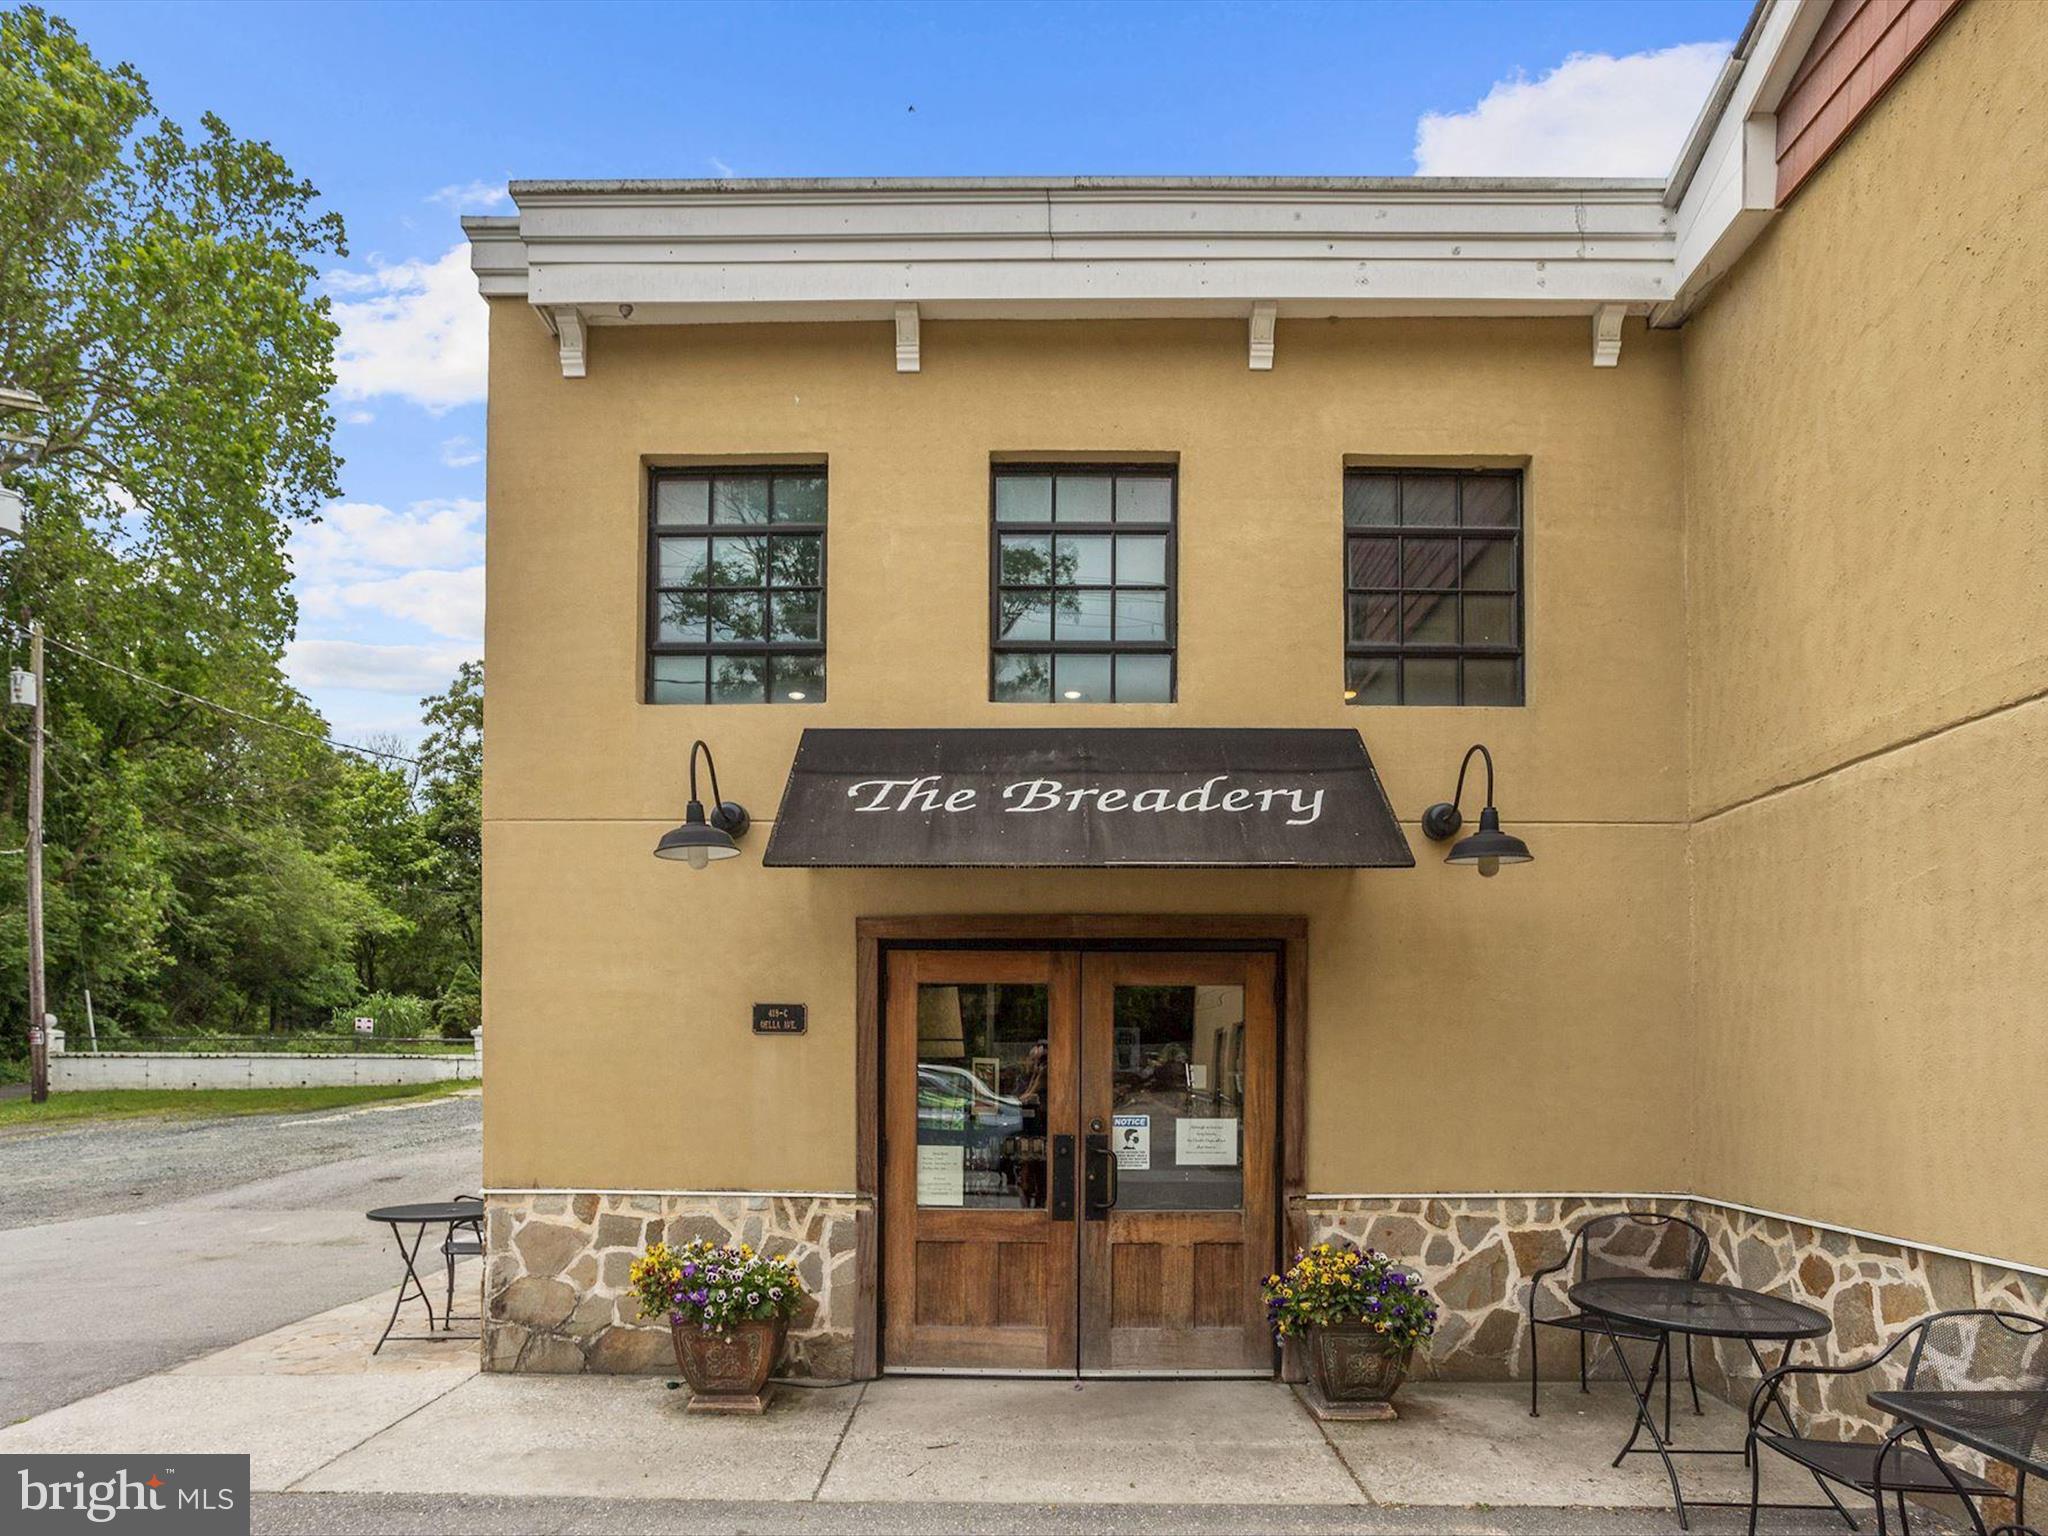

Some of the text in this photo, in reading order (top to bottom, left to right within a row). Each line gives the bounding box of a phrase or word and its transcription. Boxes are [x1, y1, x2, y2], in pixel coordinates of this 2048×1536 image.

[847, 775, 1326, 826] The Breadery
[1114, 1118, 1146, 1127] NOTICE
